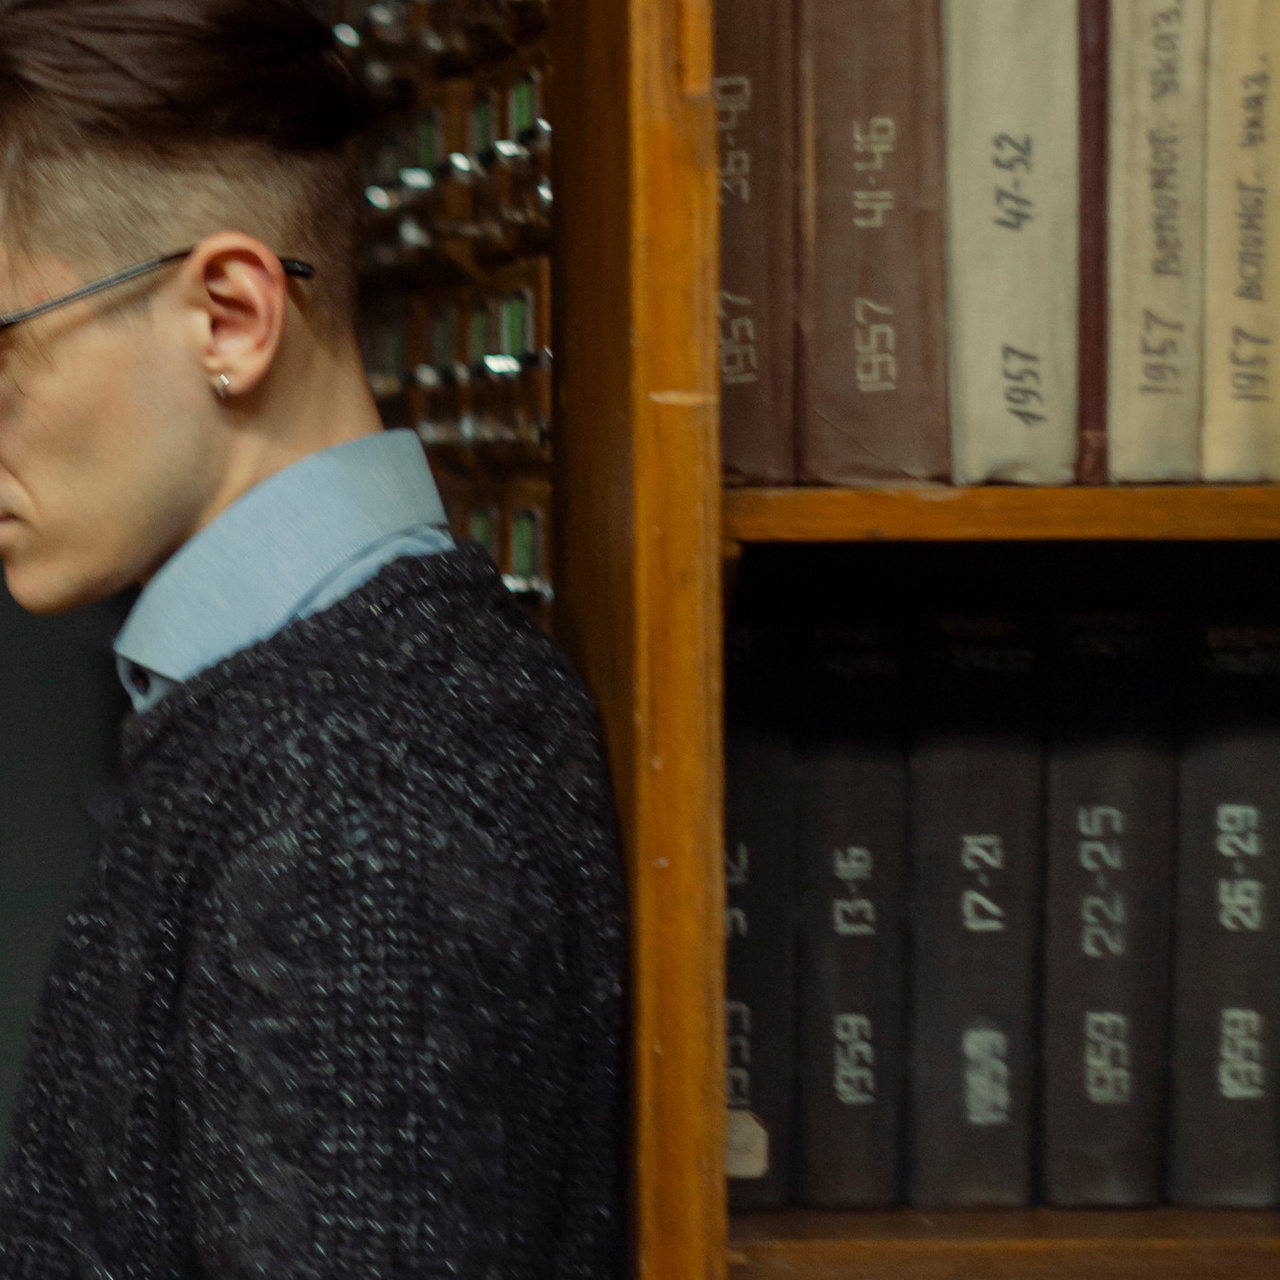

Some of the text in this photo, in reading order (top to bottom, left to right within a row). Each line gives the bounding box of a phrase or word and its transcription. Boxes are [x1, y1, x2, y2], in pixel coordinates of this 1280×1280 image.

[851, 114, 898, 393] 1957 41-46
[989, 131, 1048, 428] 1957 47-52
[718, 289, 758, 384] 1957
[1136, 308, 1185, 398] 1957
[1228, 325, 1274, 404] 1957
[961, 834, 1006, 933] 17-21
[1078, 805, 1127, 959] 22-25
[1217, 803, 1265, 932] 26-29
